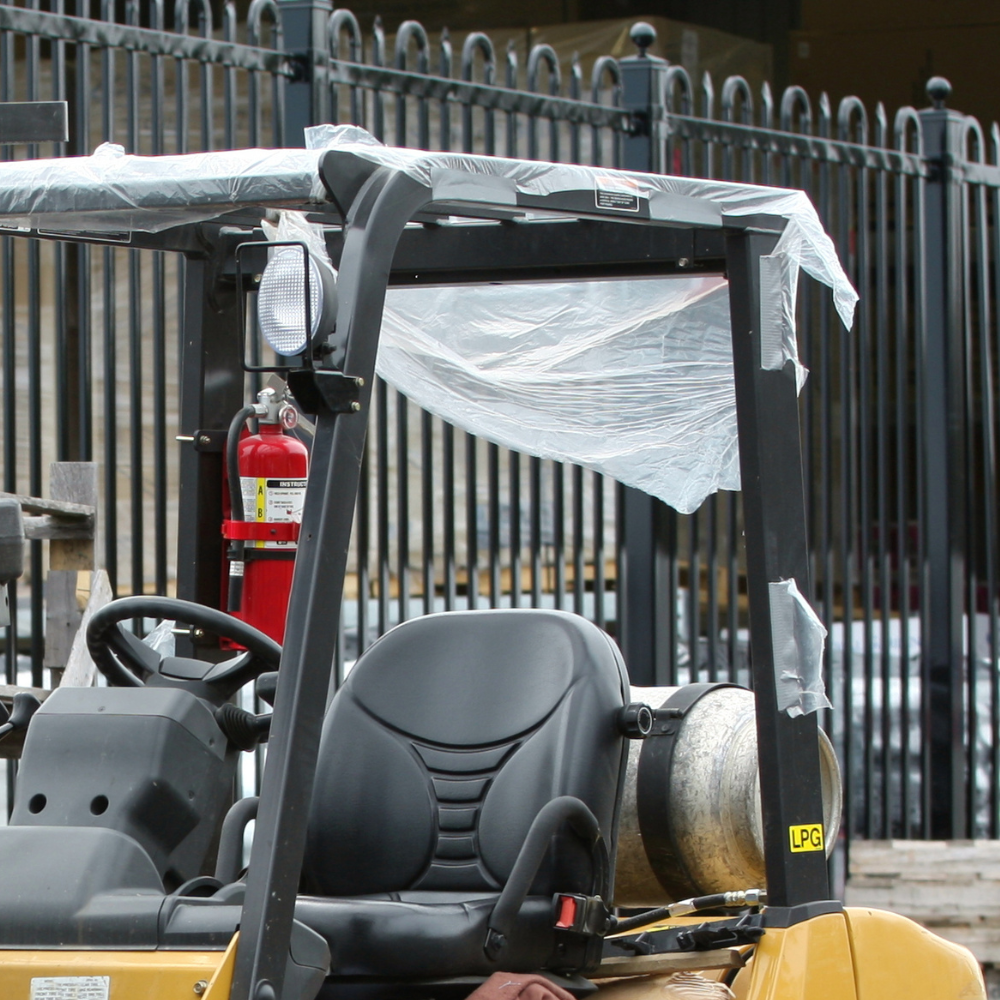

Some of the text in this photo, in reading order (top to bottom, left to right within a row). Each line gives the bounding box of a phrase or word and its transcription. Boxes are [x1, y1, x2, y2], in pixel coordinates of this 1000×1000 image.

[258, 486, 263, 495] A
[258, 508, 263, 518] B
[792, 828, 822, 848] LPG
